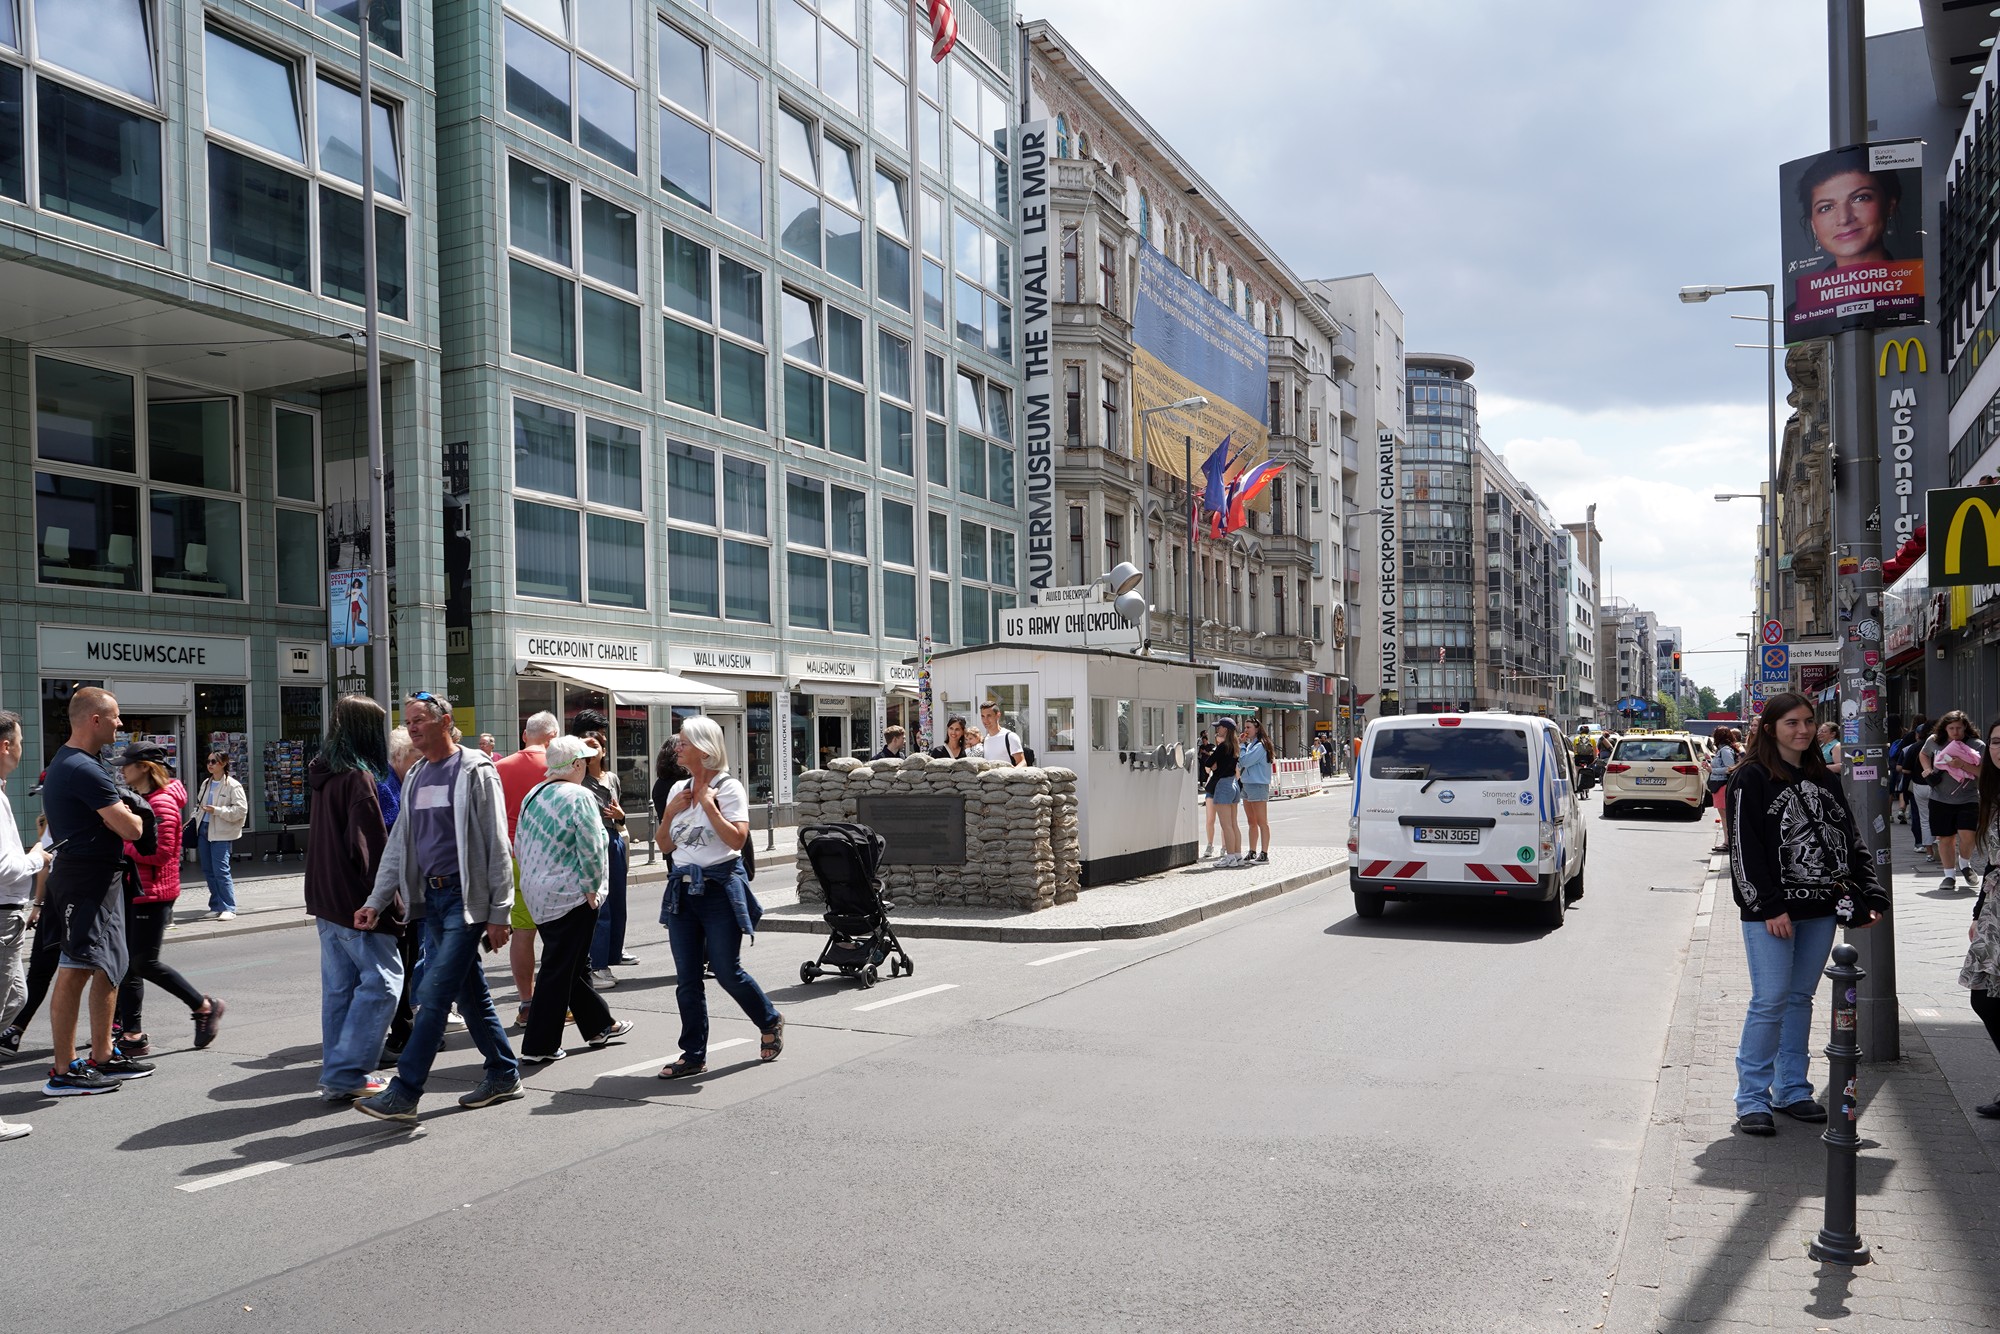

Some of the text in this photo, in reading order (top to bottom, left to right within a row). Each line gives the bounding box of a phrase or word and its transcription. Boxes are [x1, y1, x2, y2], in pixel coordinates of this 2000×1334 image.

[1875, 157, 1915, 166] Wagenknecht
[1810, 268, 1913, 290] MAULKORB oder
[1820, 279, 1903, 302] MEINUNG?
[1794, 296, 1915, 322] Sie haben JETZT die Wahl!
[1021, 129, 1052, 604] AUERMUSEUM THE WALL LE MUR
[1380, 433, 1396, 684] HAUS AM CHECKPOINT CHARLIE
[330, 572, 367, 580] DESTINATION
[1007, 618, 1023, 637] US
[1028, 615, 1060, 635] ARMY
[86, 641, 207, 666] MUSEUMSCAFE
[528, 638, 639, 663] CHECKPOINT CHARLIE
[693, 651, 752, 670] WALL MUSEUM
[806, 660, 856, 676] MAUERMUSEUM
[449, 676, 466, 685] Tagen
[1217, 671, 1302, 695] MAUERSHOP IM MAUERMUSEUM
[1764, 670, 1787, 679] TAXI
[337, 678, 366, 692] MAUER
[1481, 790, 1517, 798] Stromnetz
[1496, 797, 1517, 805] Berlin
[1420, 829, 1478, 841] B SN 305E
